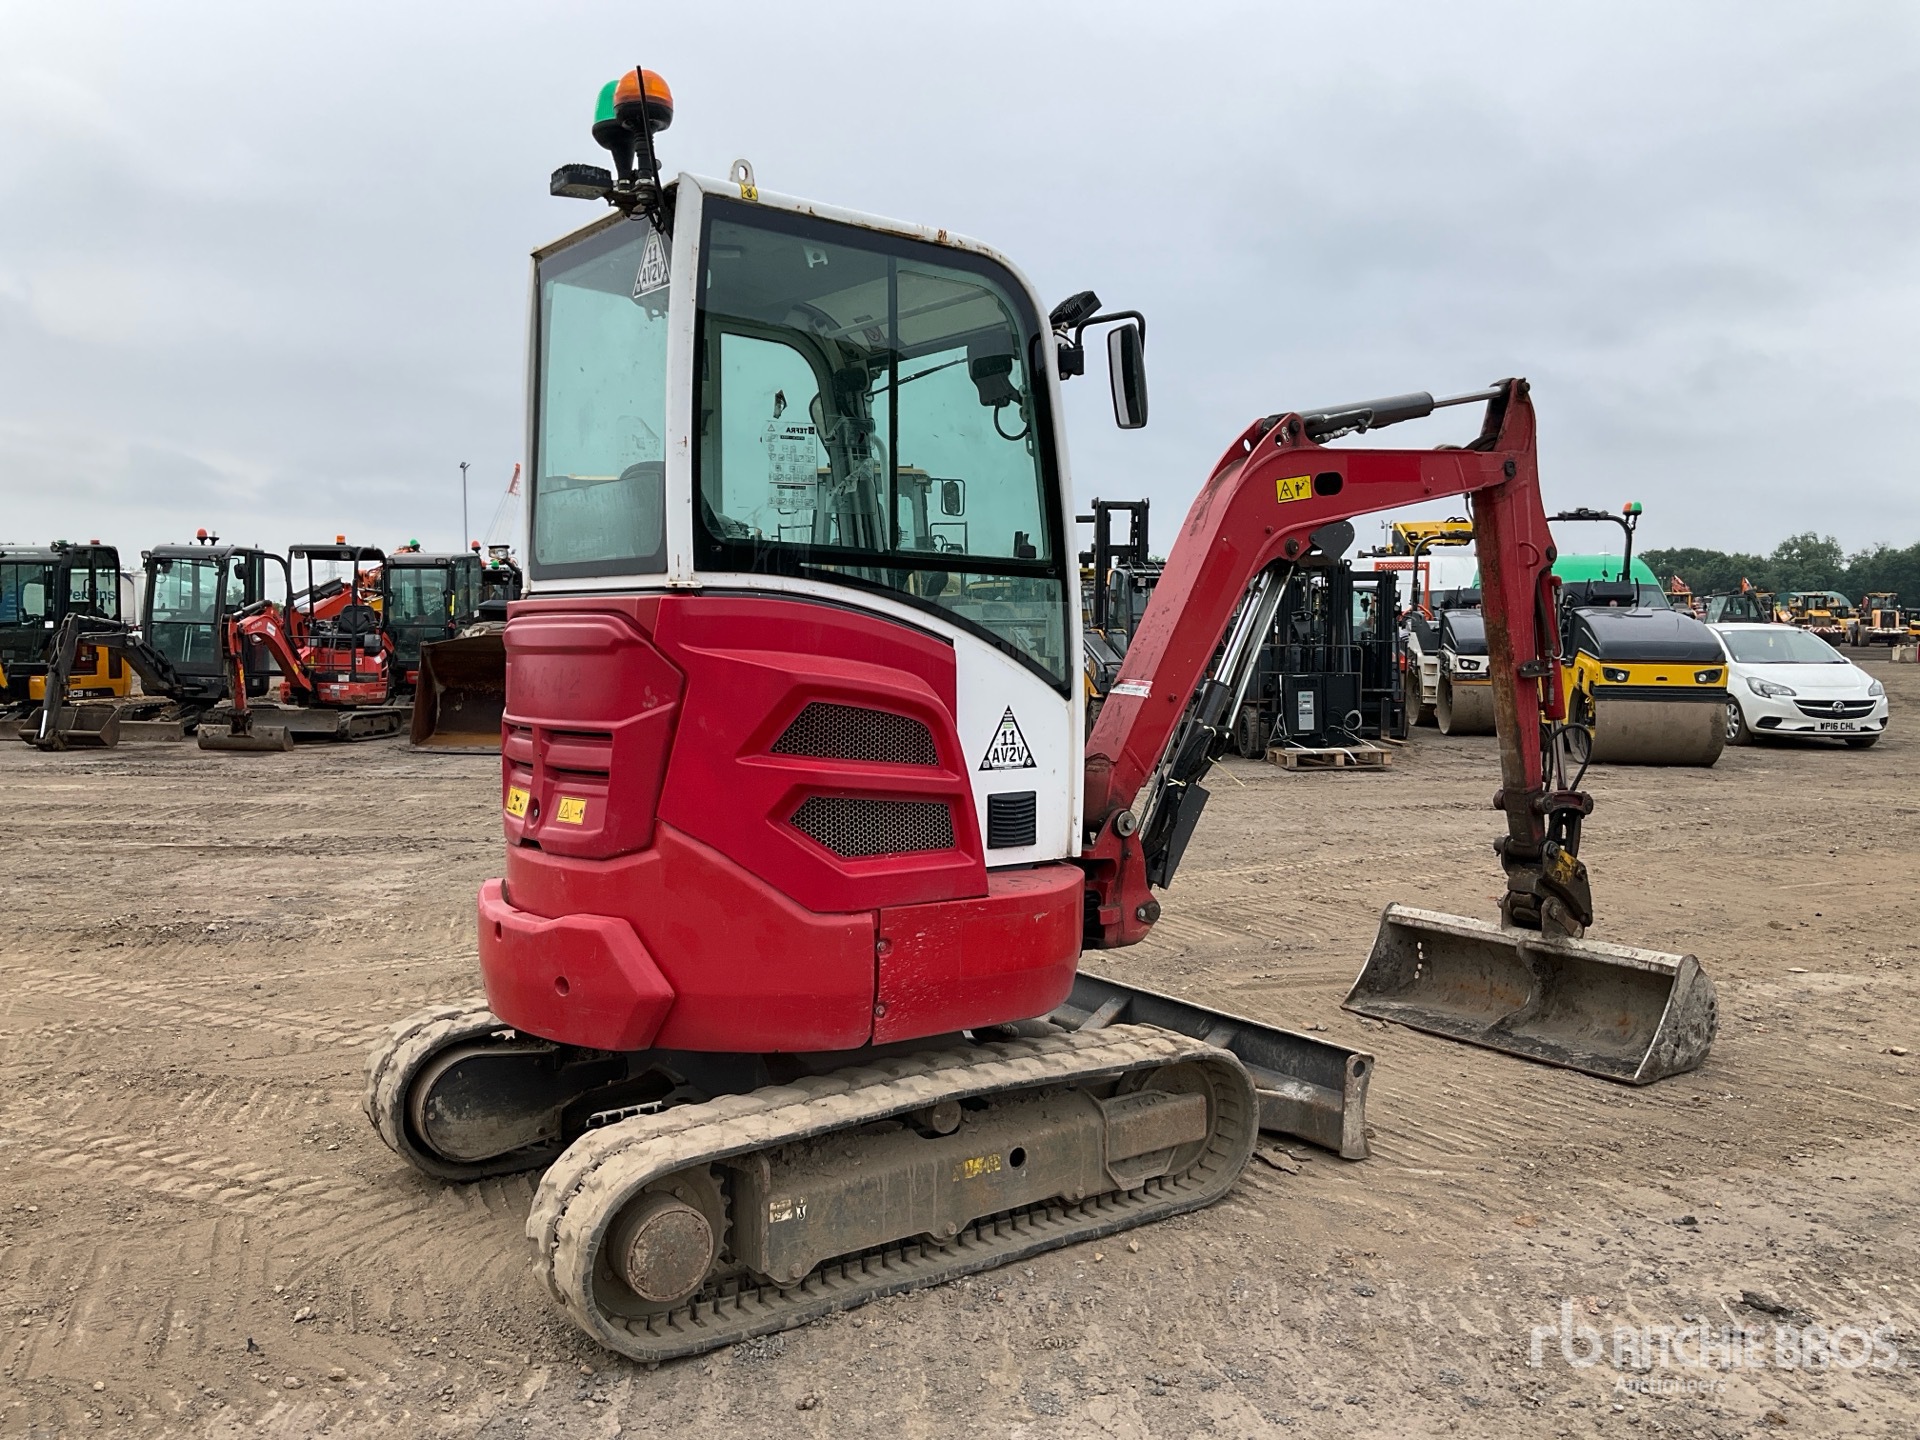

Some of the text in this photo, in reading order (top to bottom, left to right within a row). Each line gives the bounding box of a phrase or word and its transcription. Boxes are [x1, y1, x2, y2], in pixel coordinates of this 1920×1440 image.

[648, 244, 658, 263] 11
[642, 260, 663, 285] AV2V
[70, 589, 116, 600] erins
[1840, 722, 1855, 730] CHL
[1001, 730, 1016, 746] 11
[992, 746, 1024, 763] AV2V
